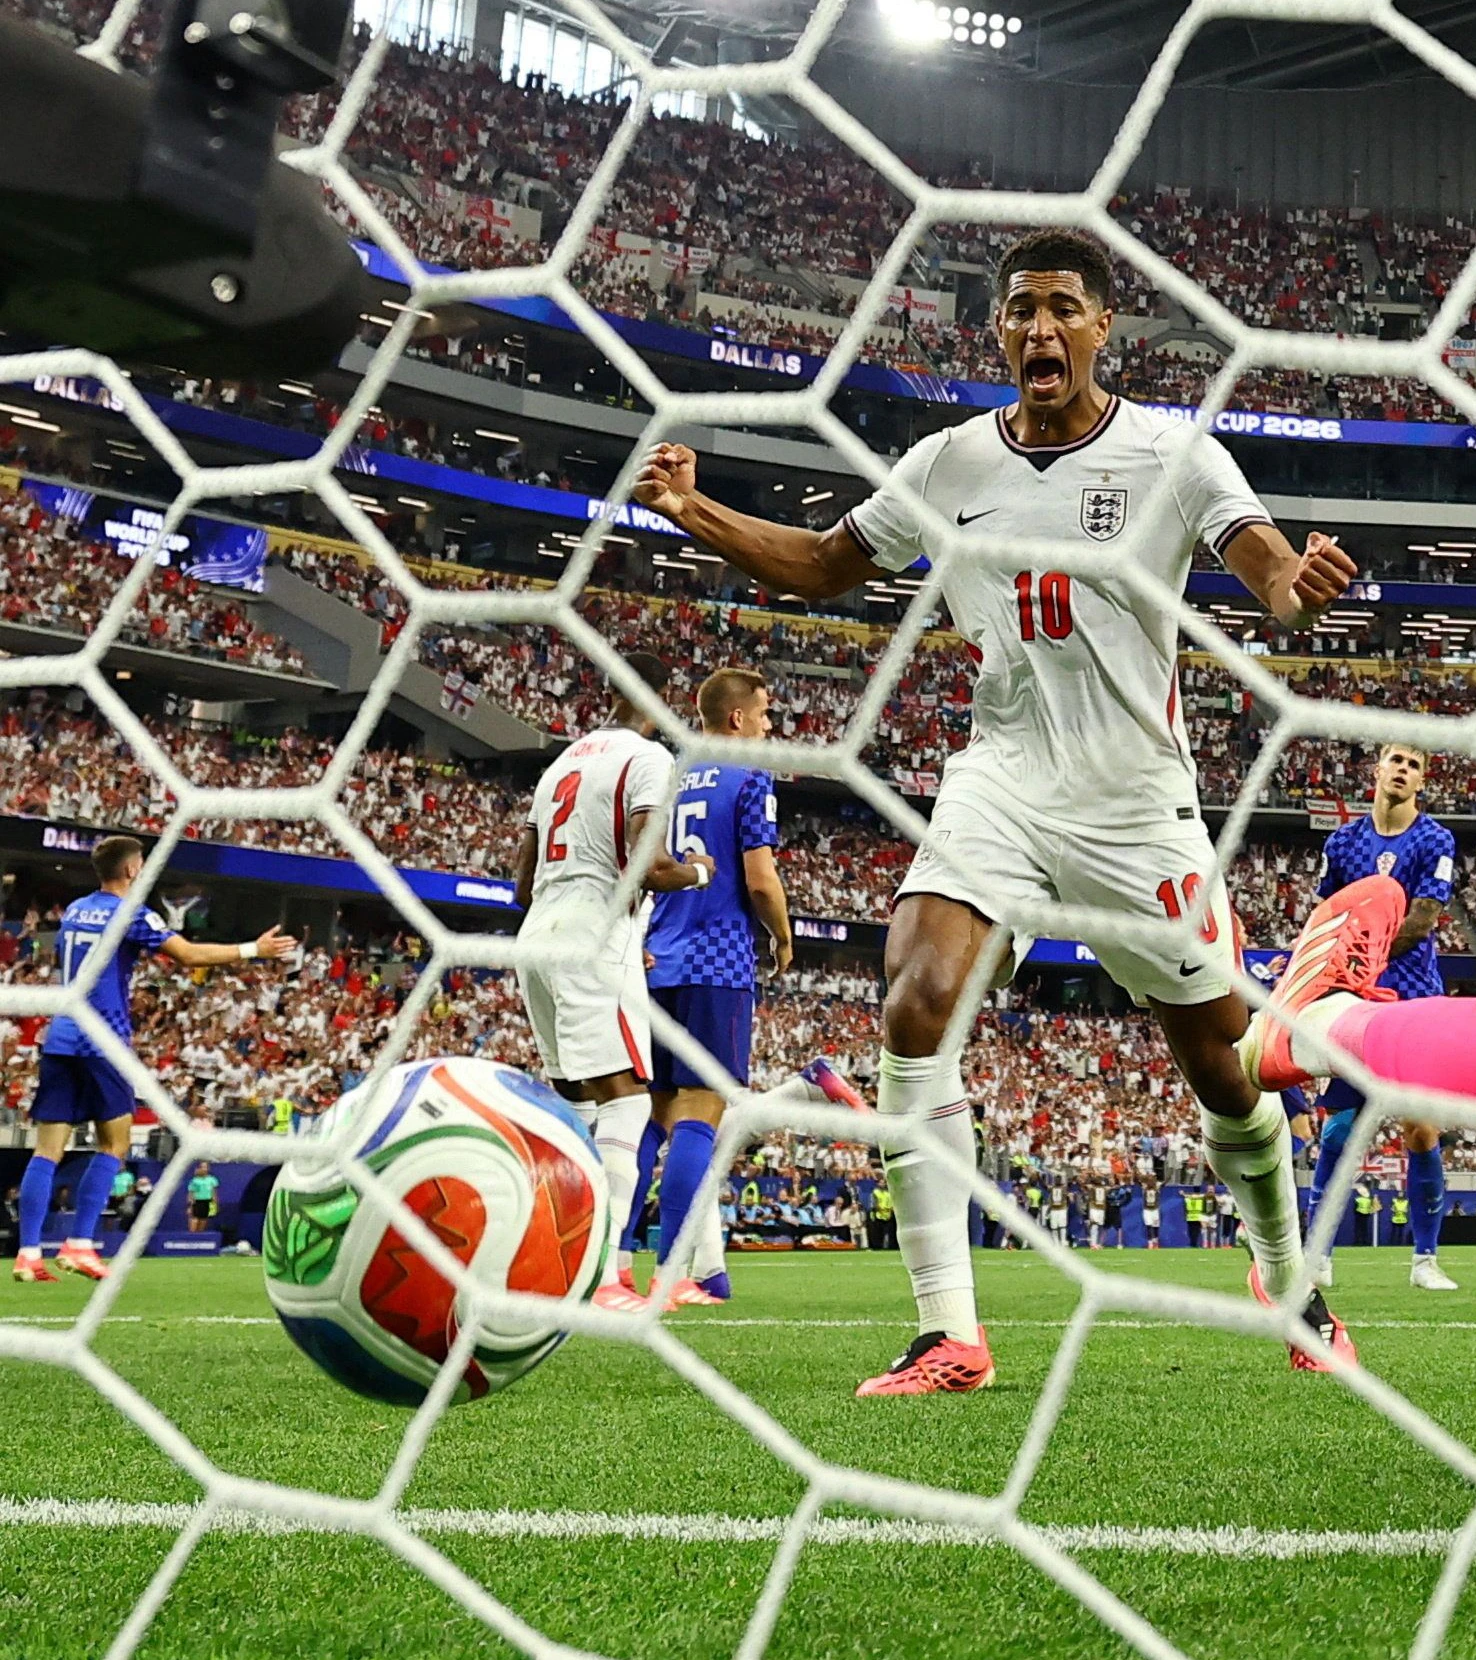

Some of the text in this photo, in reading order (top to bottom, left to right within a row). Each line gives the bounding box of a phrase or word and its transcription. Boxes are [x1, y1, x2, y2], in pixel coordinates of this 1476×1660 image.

[710, 340, 801, 375] DALLAS
[34, 374, 125, 412] DALLAS
[1216, 411, 1261, 433] CUP
[1263, 416, 1341, 439] 2026
[1015, 570, 1074, 641] 10
[546, 770, 582, 863] 2
[795, 920, 847, 941] DALLAS
[1156, 872, 1219, 945] 10
[63, 930, 102, 987] 17
